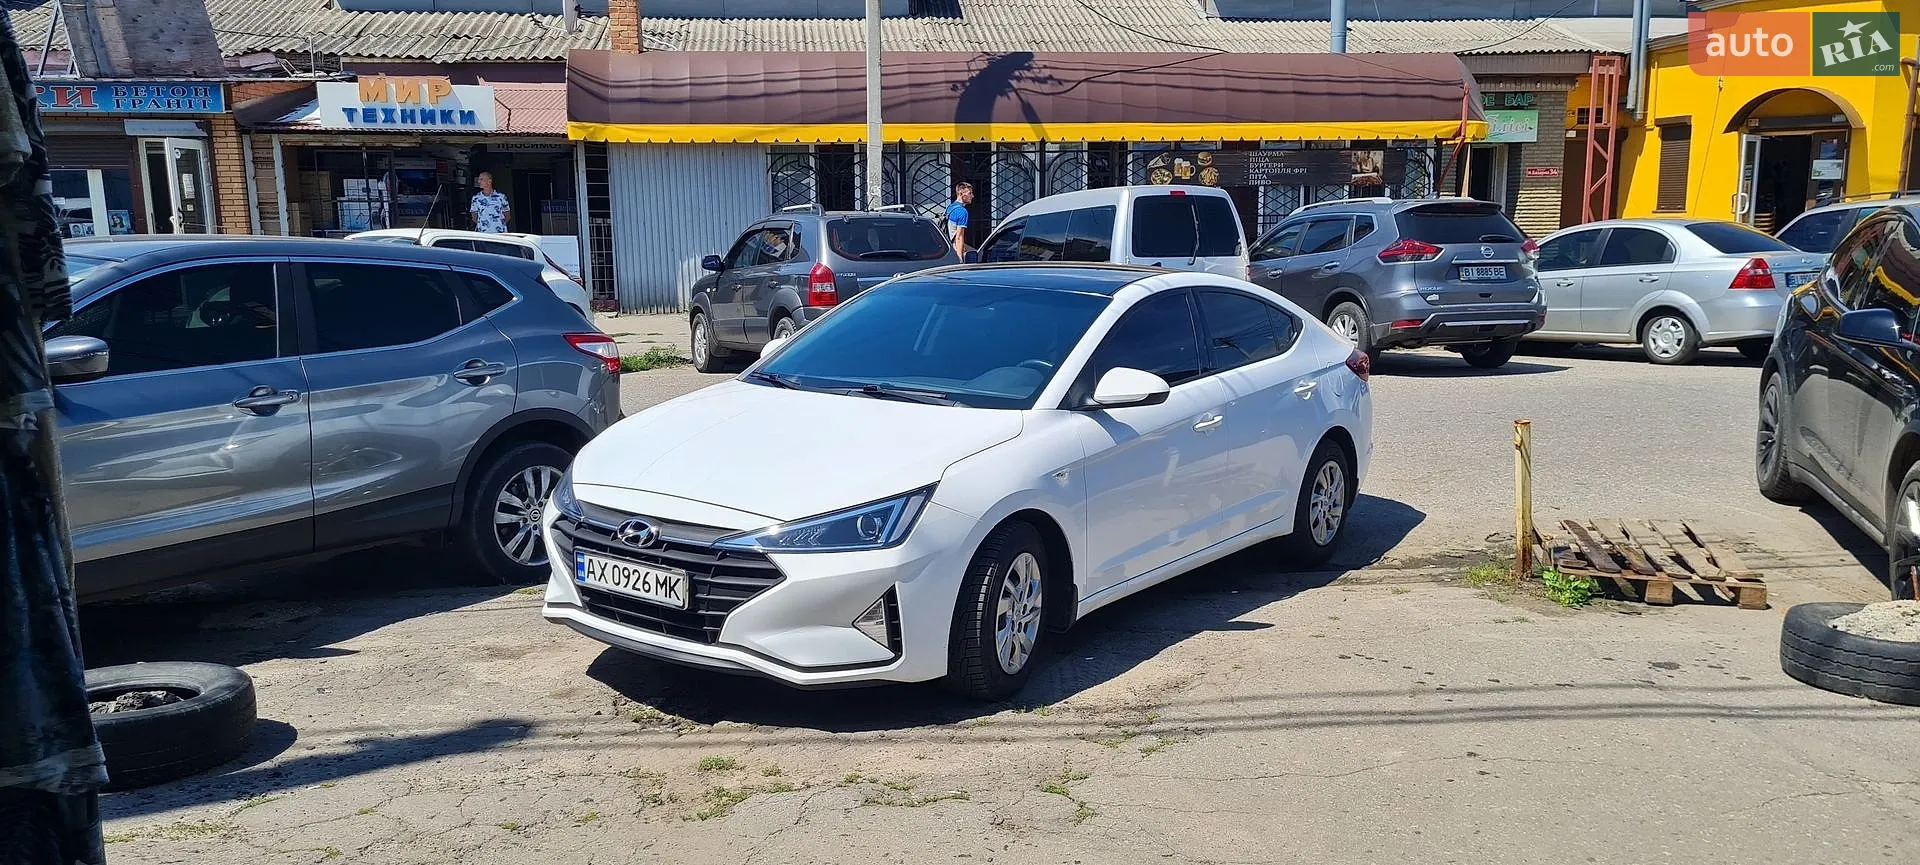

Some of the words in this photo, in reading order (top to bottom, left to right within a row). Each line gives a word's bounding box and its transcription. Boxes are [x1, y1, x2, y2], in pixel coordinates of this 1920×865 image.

[112, 86, 211, 98] БЕТОН
[359, 78, 452, 105] МИР
[112, 98, 213, 110] ГРАНІТ
[1504, 93, 1534, 106] БАР
[342, 107, 477, 126] ТЕХНИКИ
[1464, 266, 1474, 276] BI
[1477, 266, 1494, 276] 8885
[1494, 266, 1505, 276] BE
[587, 558, 608, 584] AX
[612, 565, 651, 593] 0926
[655, 574, 681, 601] MK
